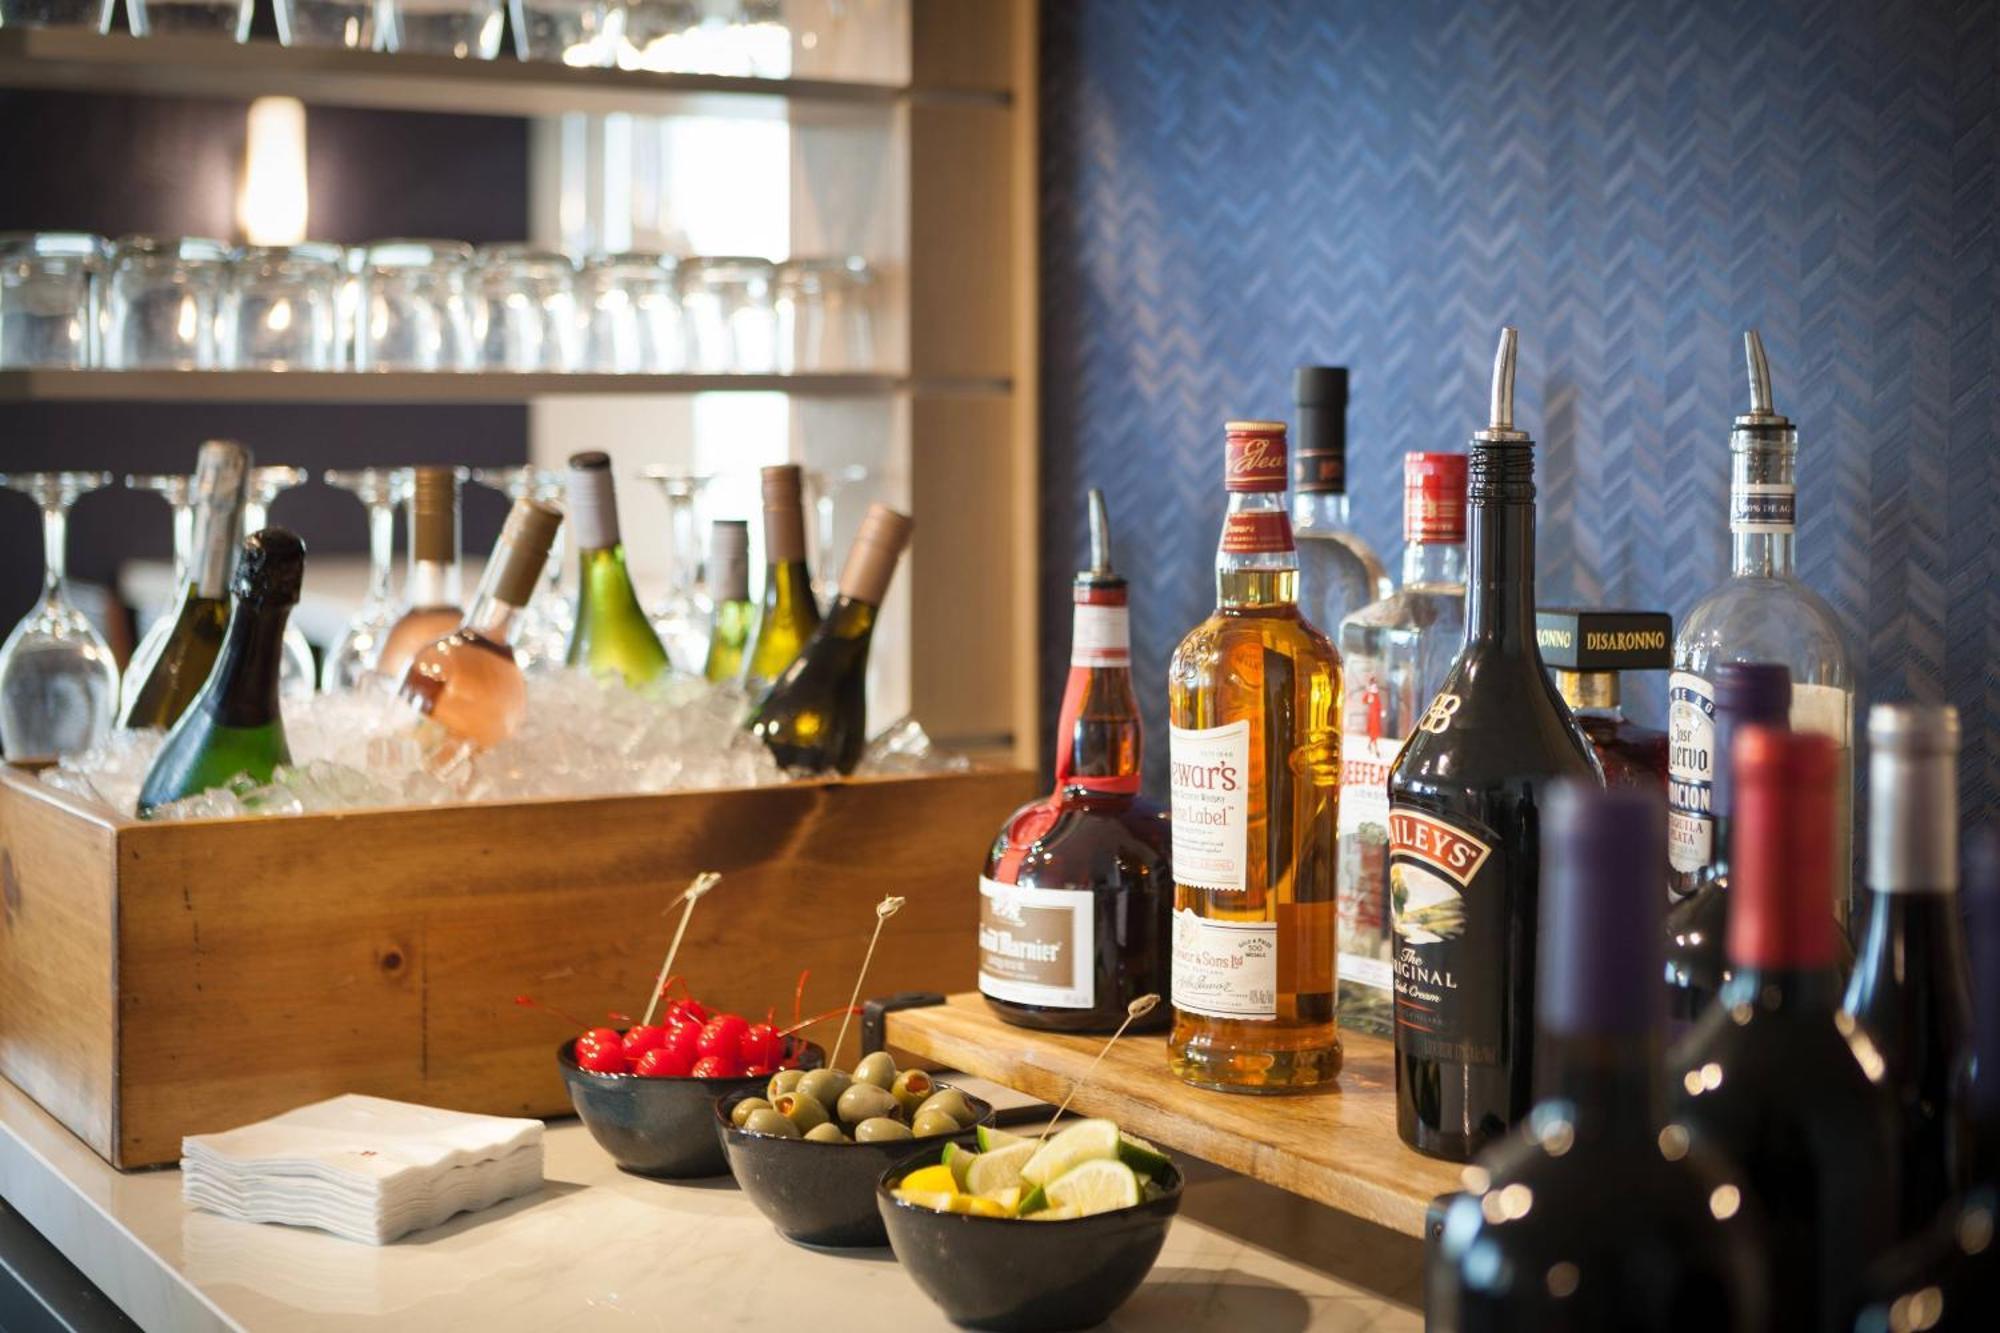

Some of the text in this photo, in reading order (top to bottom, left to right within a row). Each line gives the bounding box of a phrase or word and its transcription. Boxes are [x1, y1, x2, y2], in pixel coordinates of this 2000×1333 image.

[1587, 632, 1665, 651] DISARONNO
[1188, 806, 1228, 826] Label
[1202, 951, 1229, 969] Sons
[1400, 947, 1423, 966] The
[1409, 985, 1441, 1003] Cream
